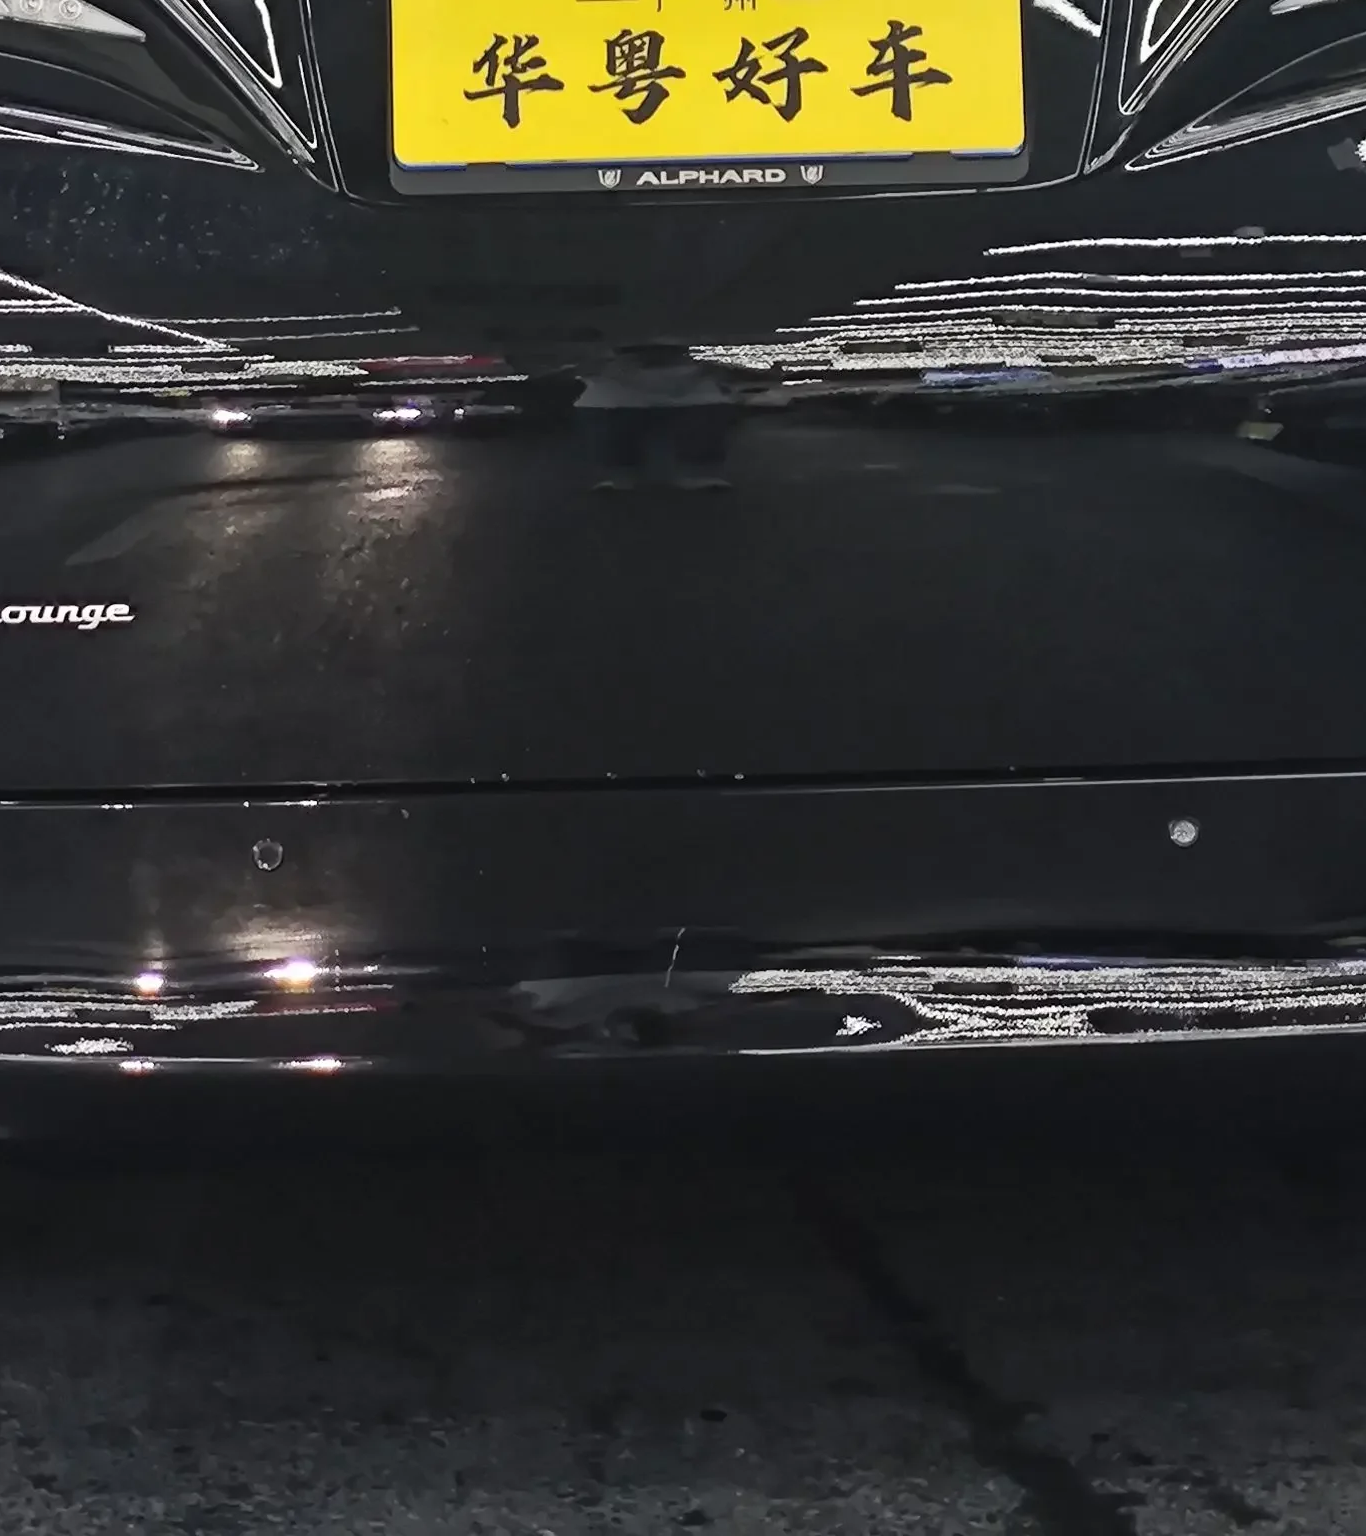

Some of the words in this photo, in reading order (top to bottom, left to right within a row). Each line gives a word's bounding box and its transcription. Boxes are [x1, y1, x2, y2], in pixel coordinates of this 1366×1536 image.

[463, 20, 953, 130] 华粤好车
[635, 166, 788, 187] ALPHARD
